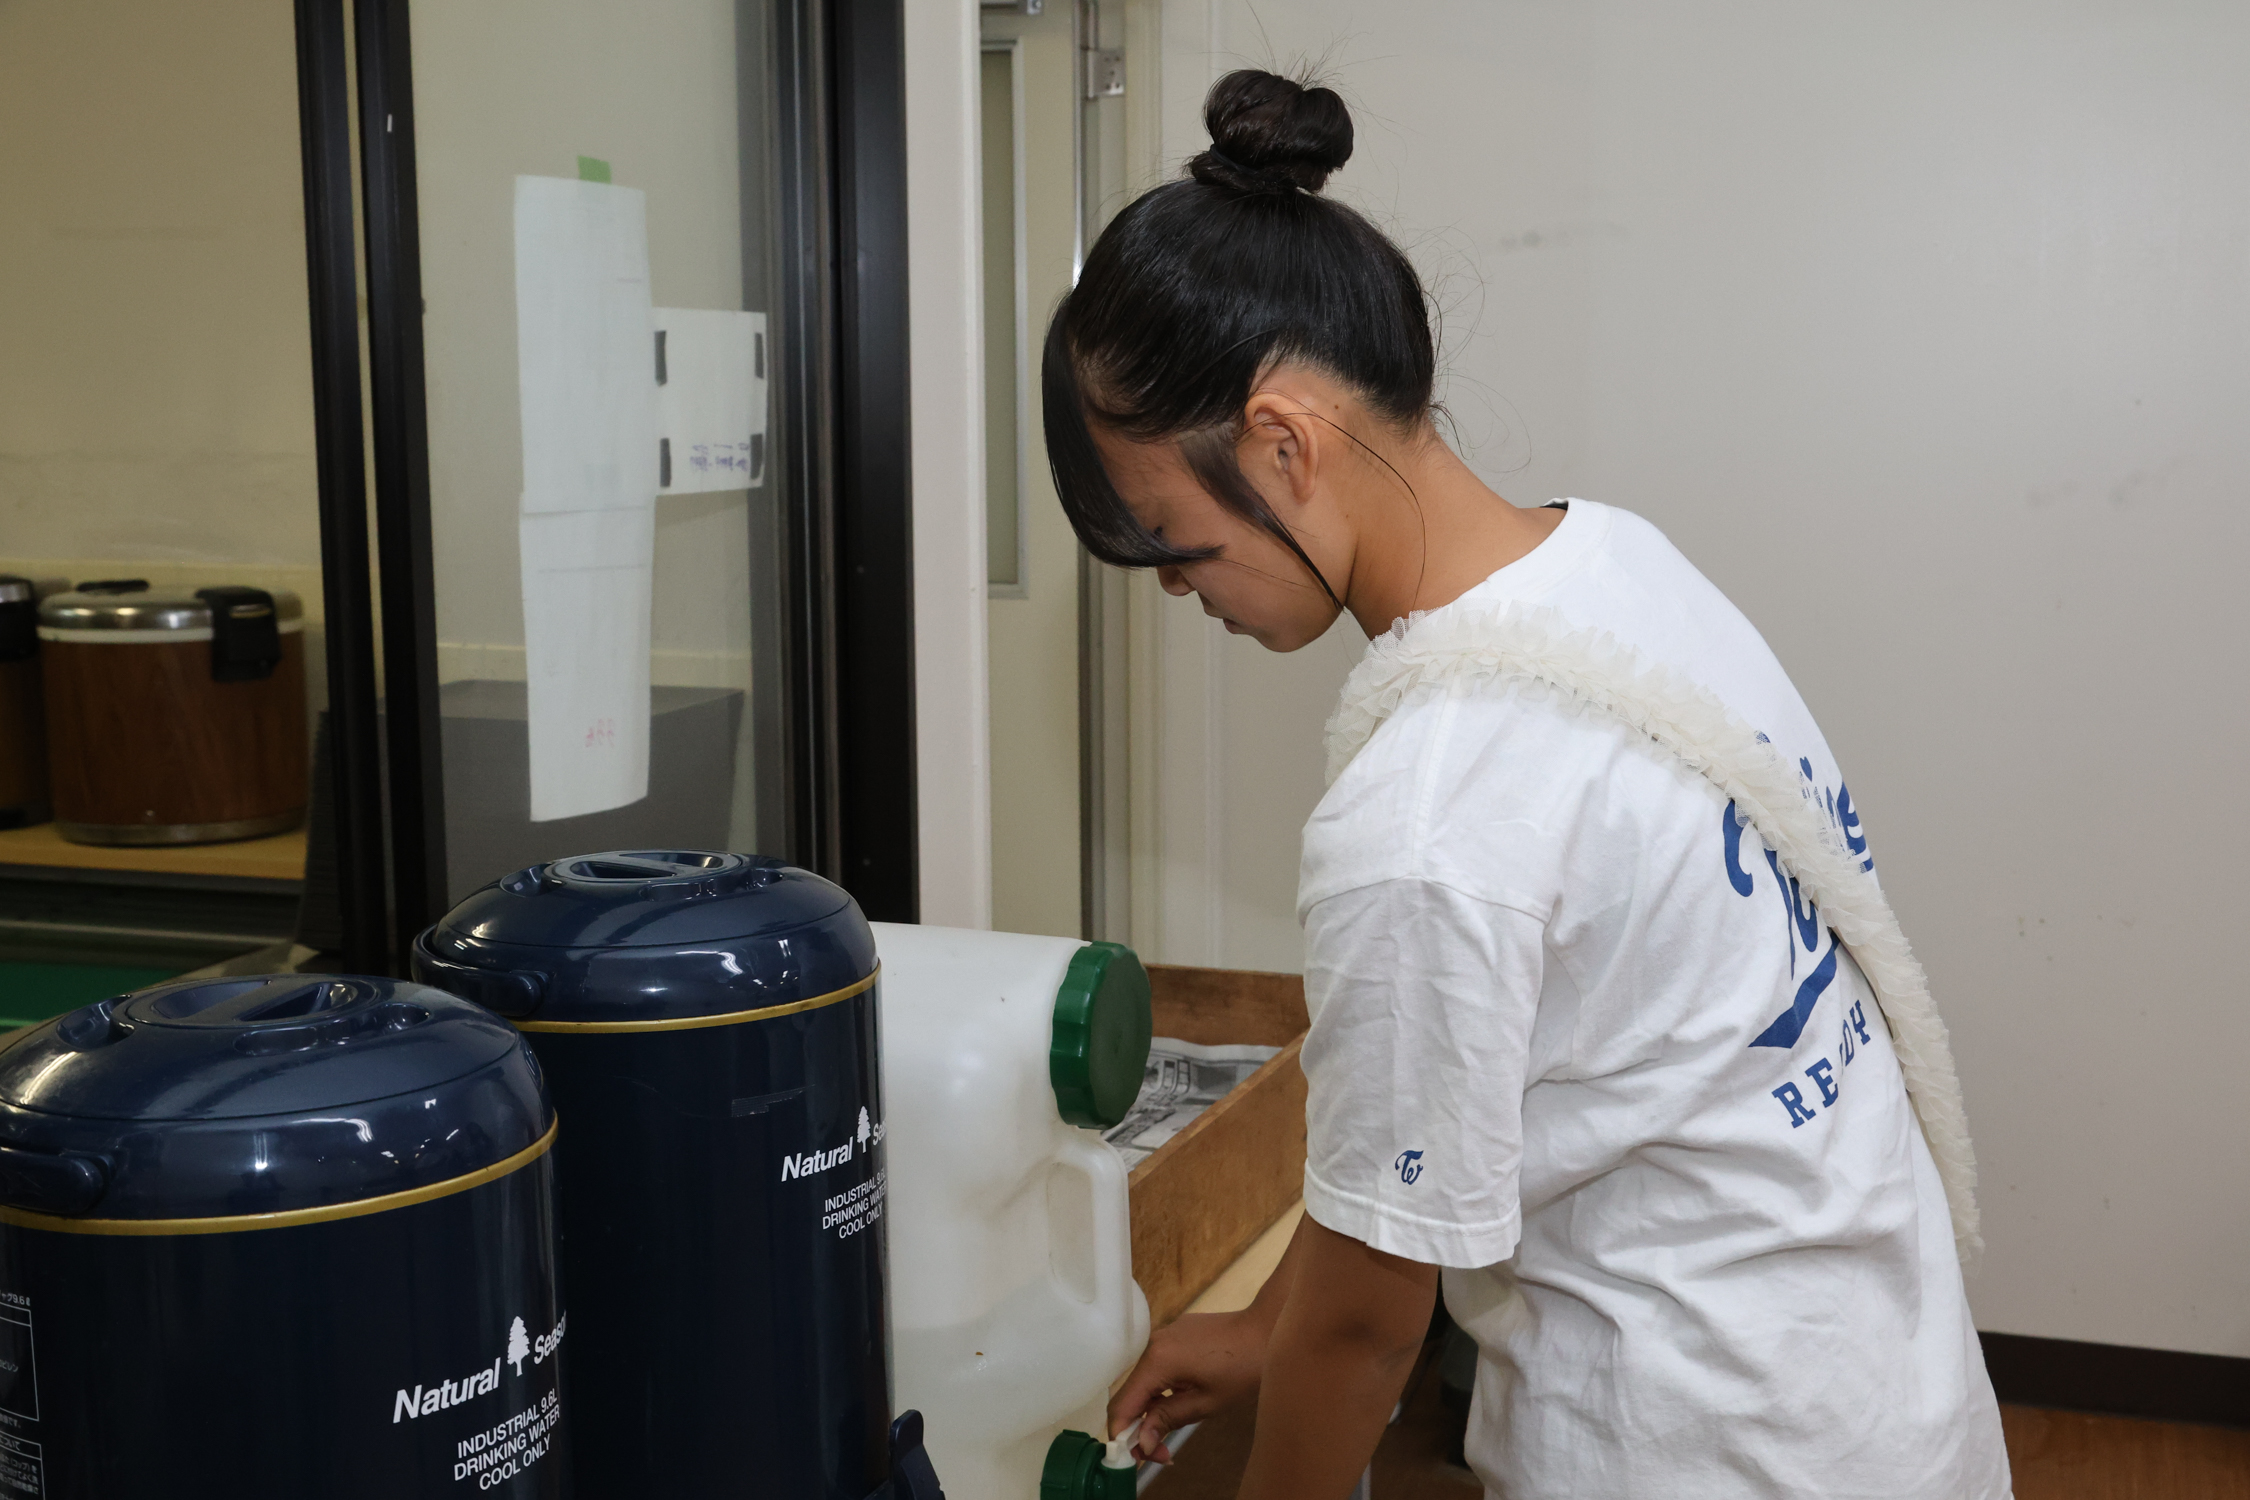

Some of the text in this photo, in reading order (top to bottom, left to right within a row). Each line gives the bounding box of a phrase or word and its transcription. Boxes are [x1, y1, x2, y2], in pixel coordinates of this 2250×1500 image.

[1771, 999, 1871, 1129] REDY
[781, 1136, 854, 1182] Natural
[822, 1197, 869, 1230] DRINKING
[825, 1176, 877, 1212] INDUSTRIAL
[838, 1201, 884, 1239] COOL ONLY
[393, 1357, 501, 1424] Natural
[454, 1404, 560, 1481] DRINKING WATER
[457, 1387, 558, 1459] INDUSTRIAL 9.6L
[479, 1433, 551, 1491] COOL ONLY
